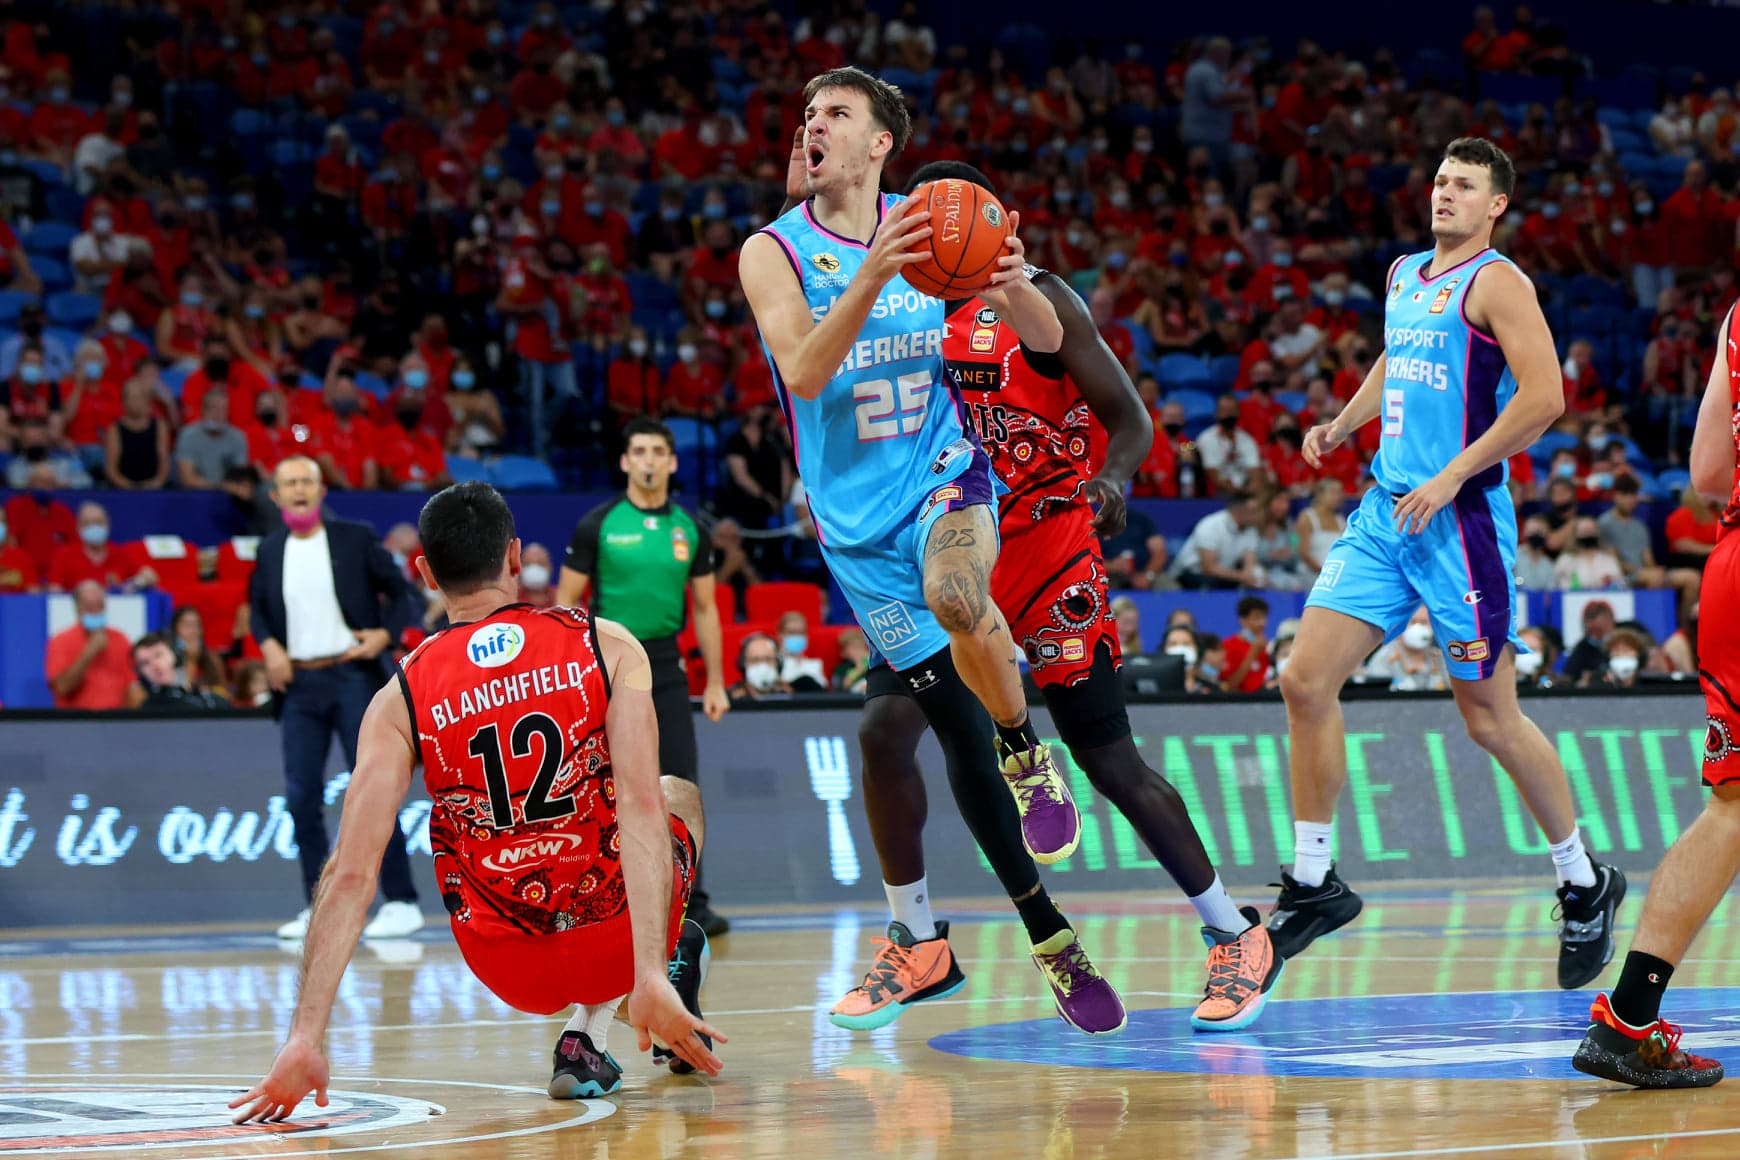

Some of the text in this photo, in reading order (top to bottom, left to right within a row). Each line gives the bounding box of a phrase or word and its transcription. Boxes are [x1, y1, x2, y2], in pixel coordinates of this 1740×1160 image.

[815, 279, 850, 289] DOCTOR
[981, 311, 995, 321] NBL
[1385, 322, 1449, 350] YSPORT
[947, 366, 997, 384] ANET
[853, 369, 933, 442] 25
[1384, 389, 1404, 437] 5
[1041, 646, 1057, 656] NBL
[430, 660, 583, 731] BLANCHFIELD
[467, 711, 579, 831] 12
[56, 793, 138, 866] is
[158, 795, 300, 864] our
[498, 840, 565, 864] NKW
[559, 853, 590, 864] Holding
